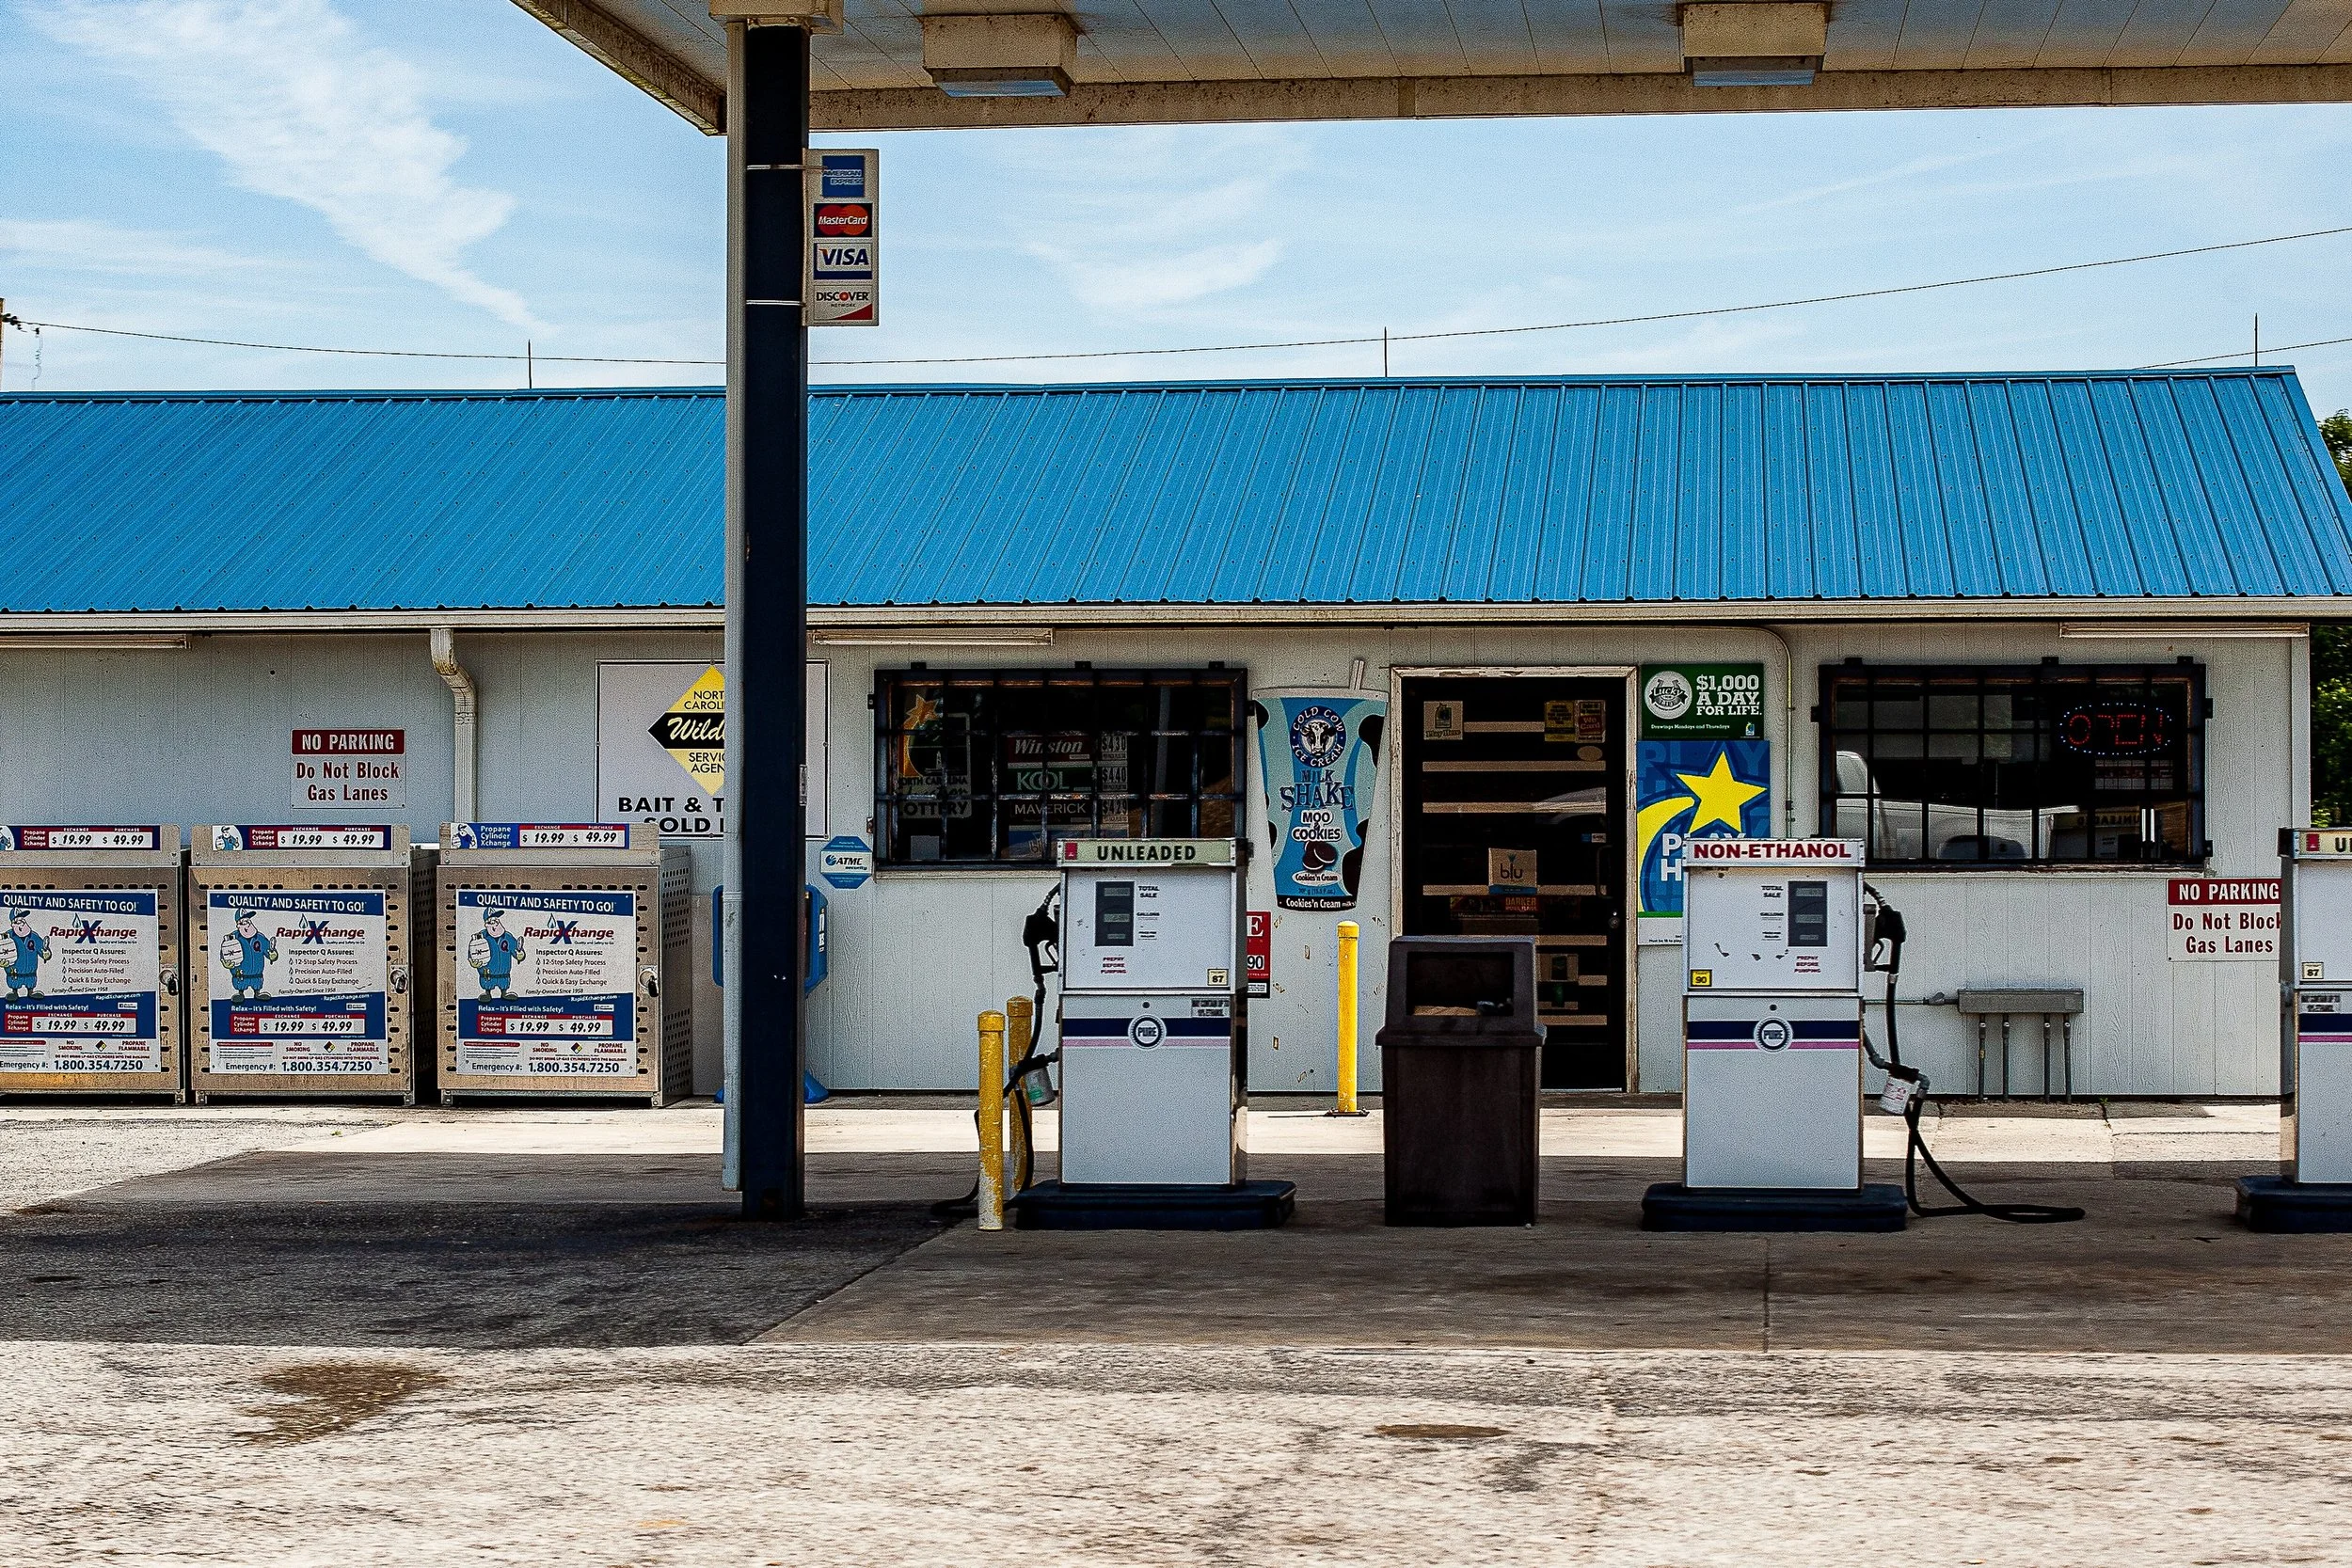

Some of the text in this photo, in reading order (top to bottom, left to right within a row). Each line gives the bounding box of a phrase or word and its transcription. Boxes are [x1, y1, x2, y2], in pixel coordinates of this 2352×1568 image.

[818, 215, 867, 226] MasterCard
[818, 248, 869, 265] VISA
[816, 292, 869, 302] DISCOVER
[1696, 674, 1759, 691] $1,000
[693, 690, 724, 699] NORT
[1653, 688, 1683, 697] Lucky
[1696, 692, 1711, 705] A
[684, 701, 725, 709] CAROLI
[1696, 706, 1762, 715] FOR LIFE.
[1293, 706, 1344, 732] COLD COW
[302, 734, 394, 750] NO PARKING
[1292, 743, 1343, 767] ICE CREAM
[296, 762, 399, 779] Do Not Block
[691, 764, 725, 773] AGEN
[1017, 771, 1070, 790] KOOL
[1301, 769, 1335, 783] MILK
[308, 784, 388, 800] Gas Lanes
[1279, 782, 1355, 812] SHAKE
[618, 798, 675, 813] BAIT
[684, 798, 702, 813] &
[898, 801, 967, 816] OTTRY
[1015, 803, 1086, 815] MAVERICK
[1302, 812, 1330, 823] MOO
[62, 834, 144, 846] 19.99 49.99
[292, 833, 374, 845] 19.99 49.99
[534, 832, 616, 843] 19.99 49.99
[1292, 829, 1342, 839] COOKIES
[1097, 845, 1196, 861] UNLEADED
[1693, 844, 1851, 859] NON-ETHANOL
[1501, 863, 1523, 879] blu
[2179, 883, 2279, 900] NO PARKING
[3, 895, 137, 912] QUALITY AND SAFETY TO GO!
[228, 895, 365, 912] QUALITY AND SAFETY TO GO!
[477, 895, 614, 912] QUALITY AND SAFETY TO GO!
[1320, 899, 1341, 908] Cream
[2173, 912, 2194, 930] Do
[2202, 912, 2231, 930] Not
[2185, 936, 2273, 953] Gas Lanes
[48, 1020, 125, 1031] 19.99 49.99
[274, 1022, 352, 1032] 19.99 49.99
[519, 1022, 600, 1032] 19.99 49.99
[1137, 1027, 1157, 1037] PURE
[0, 1061, 40, 1070] Emergency
[54, 1060, 143, 1070] 1.800.354.7250
[226, 1063, 267, 1072] Emergency
[281, 1061, 372, 1071] 1.800.354.7250
[472, 1063, 514, 1072] Emergency
[529, 1062, 619, 1072] 1.800.354.7250
